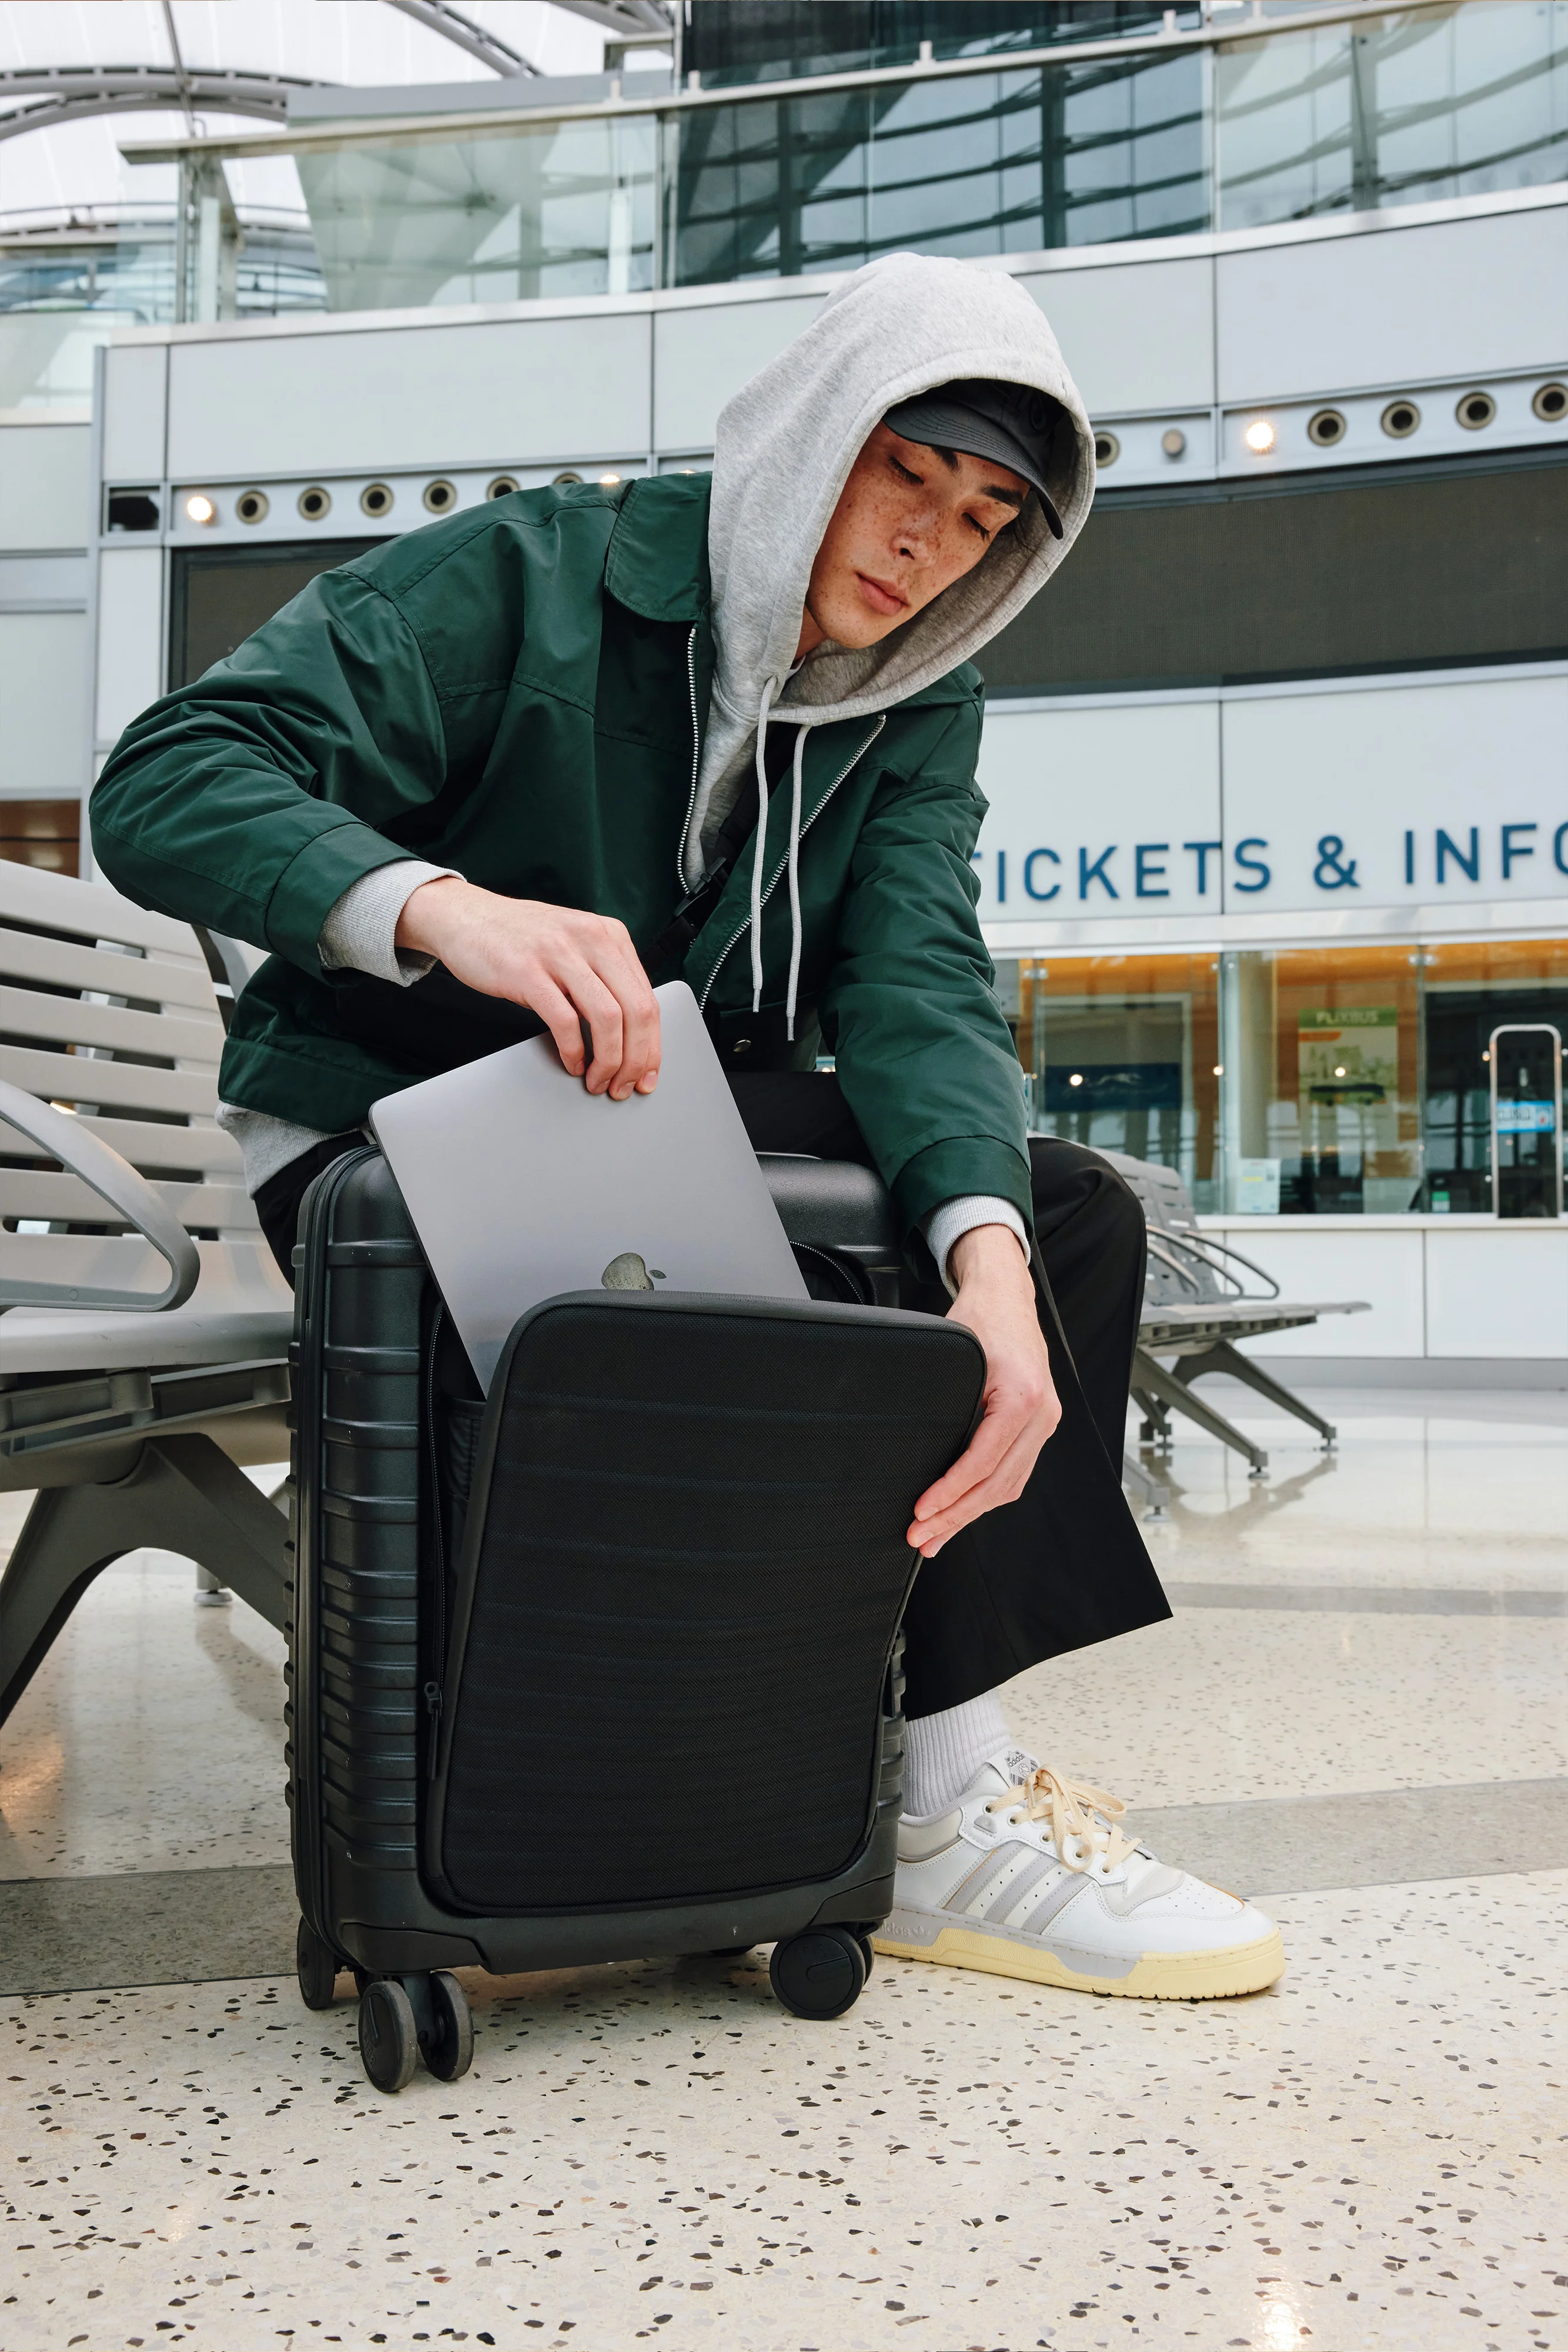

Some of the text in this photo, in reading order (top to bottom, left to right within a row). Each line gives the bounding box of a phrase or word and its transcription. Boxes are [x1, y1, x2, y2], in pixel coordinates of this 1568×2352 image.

[972, 837, 1271, 903] ICKETS
[1313, 835, 1360, 890] &
[1008, 1753, 1025, 1768] adidas
[881, 1921, 911, 1938] idas
